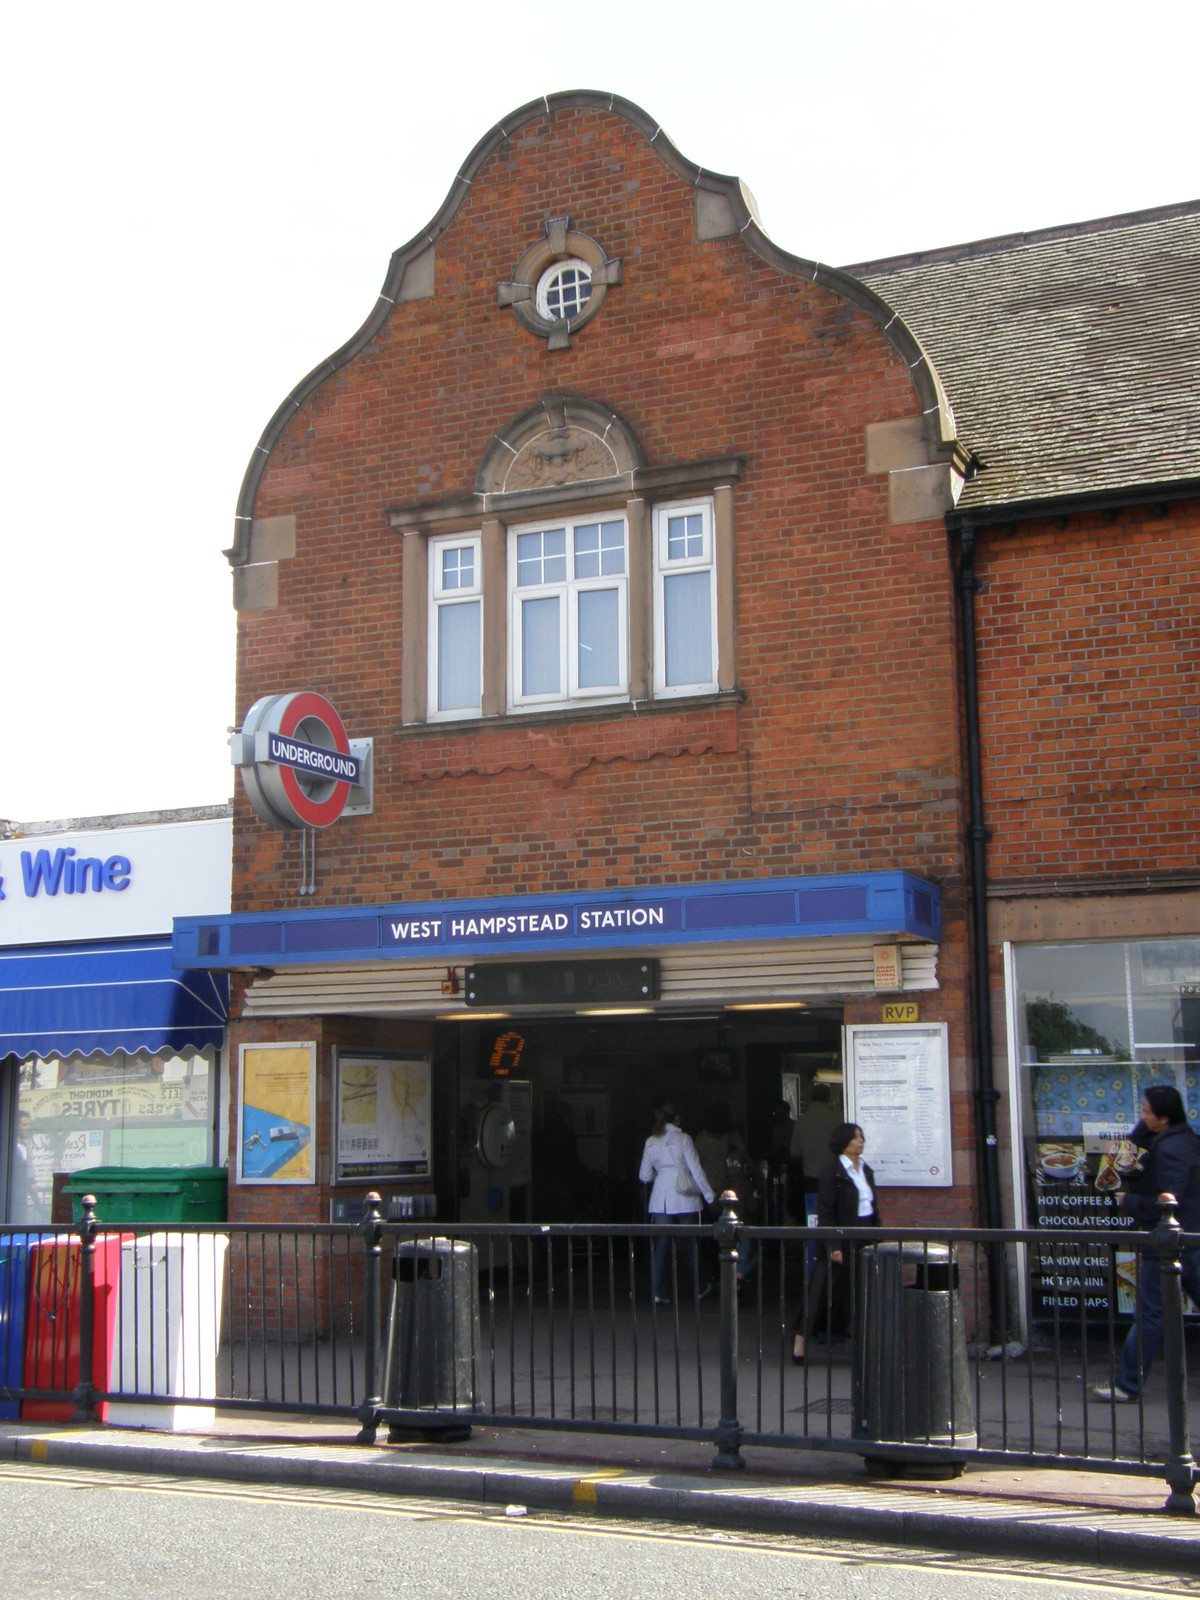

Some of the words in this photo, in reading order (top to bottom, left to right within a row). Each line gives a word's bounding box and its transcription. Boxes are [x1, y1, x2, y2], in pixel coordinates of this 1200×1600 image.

[272, 740, 356, 777] UNDERGROUND
[20, 847, 131, 897] Wine
[391, 920, 441, 940] WEST
[451, 913, 569, 936] HAMPSTEAD
[580, 907, 664, 929] STATION
[885, 1006, 915, 1018] RVP
[1038, 1196, 1060, 1206] HOT
[1062, 1196, 1102, 1206] COFFEE
[1104, 1197, 1113, 1206] &
[1040, 1256, 1109, 1267] SANDWCHES
[1084, 1298, 1109, 1307] APS
